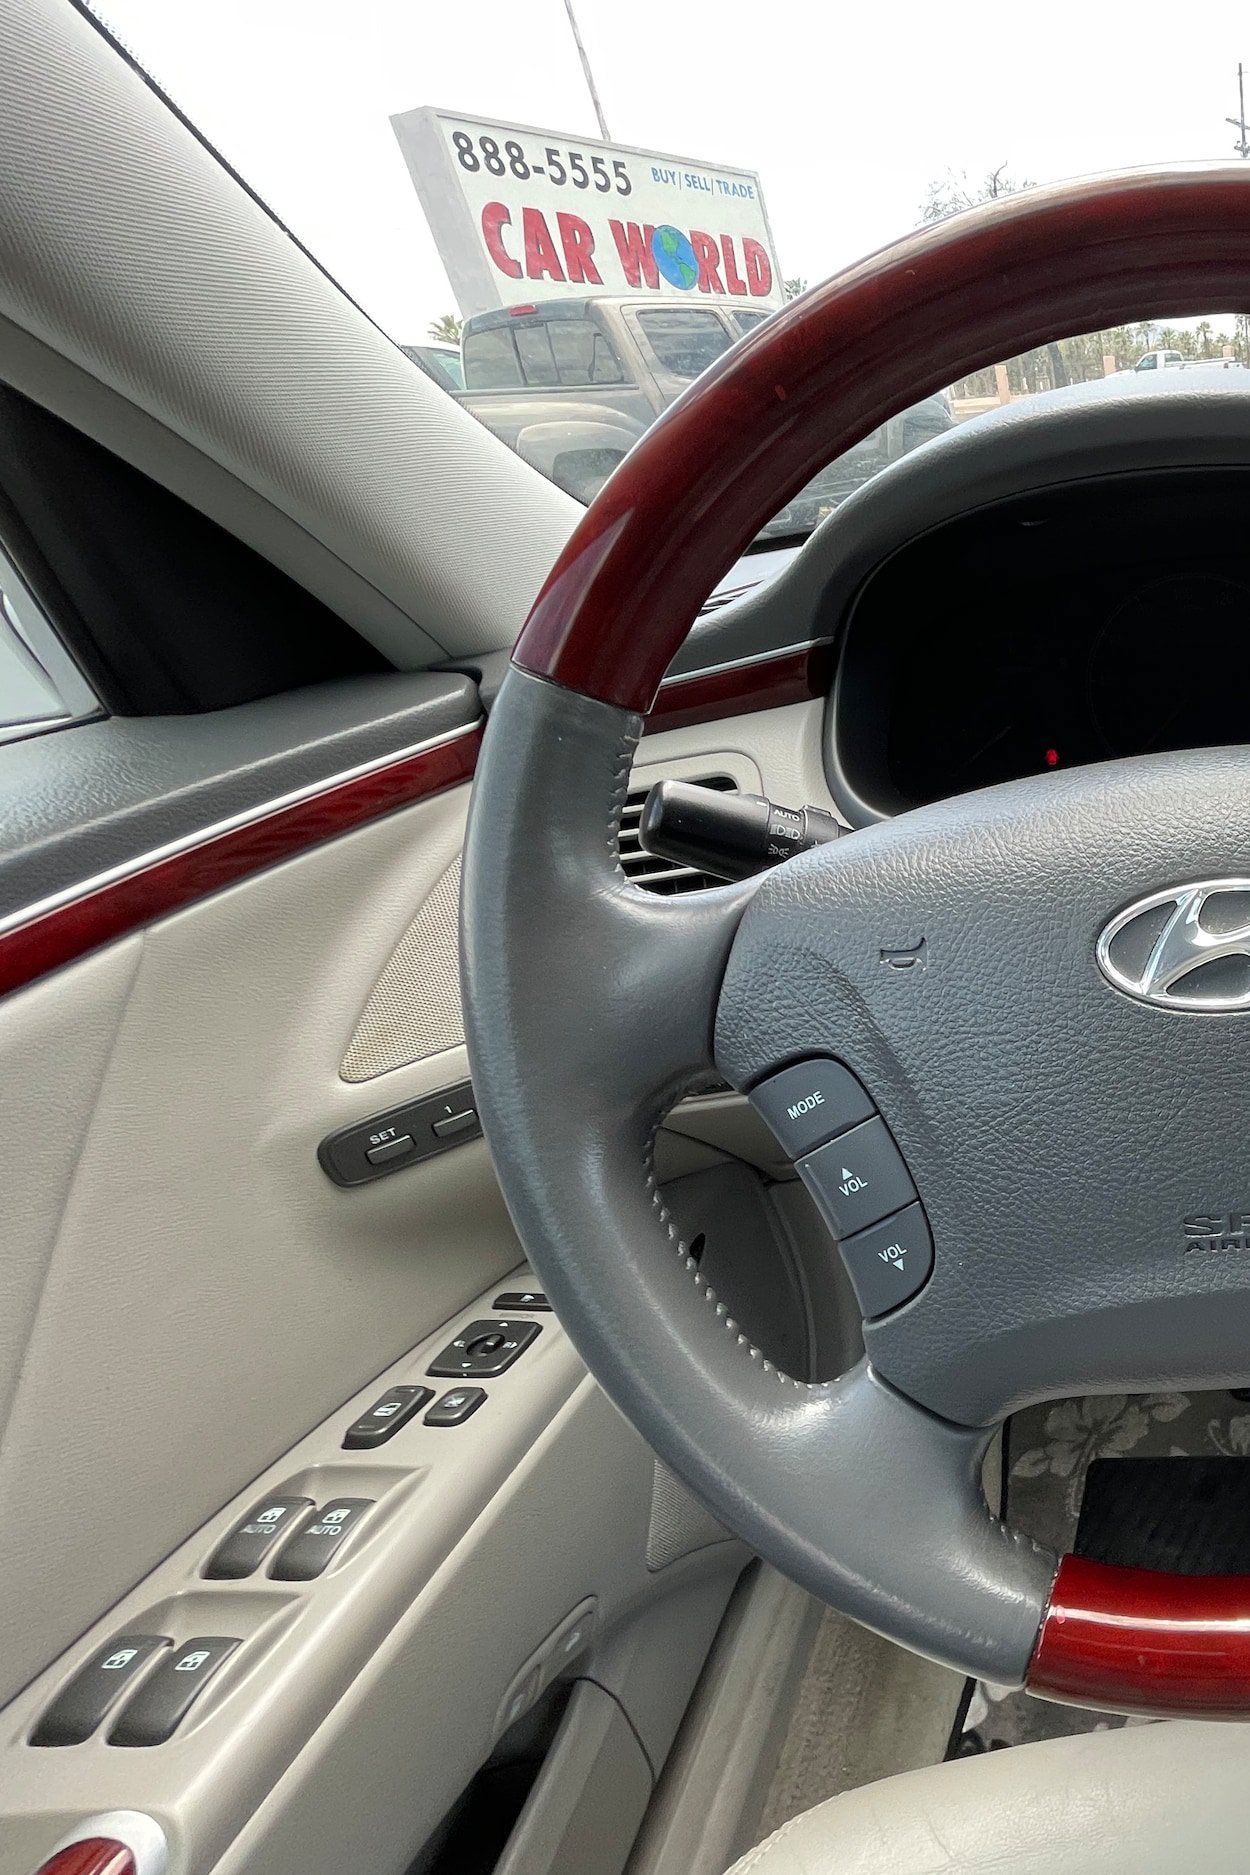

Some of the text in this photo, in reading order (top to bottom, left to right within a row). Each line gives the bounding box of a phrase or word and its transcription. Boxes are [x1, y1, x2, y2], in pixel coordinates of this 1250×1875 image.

[452, 131, 632, 196] 888-5555
[481, 201, 604, 286] CAR
[774, 809, 800, 822] AUTO
[786, 1090, 825, 1120] MODE
[369, 1127, 396, 1145] SET
[839, 1175, 868, 1197] VOL
[877, 1243, 907, 1264] VOL
[305, 1525, 342, 1536] AUTO
